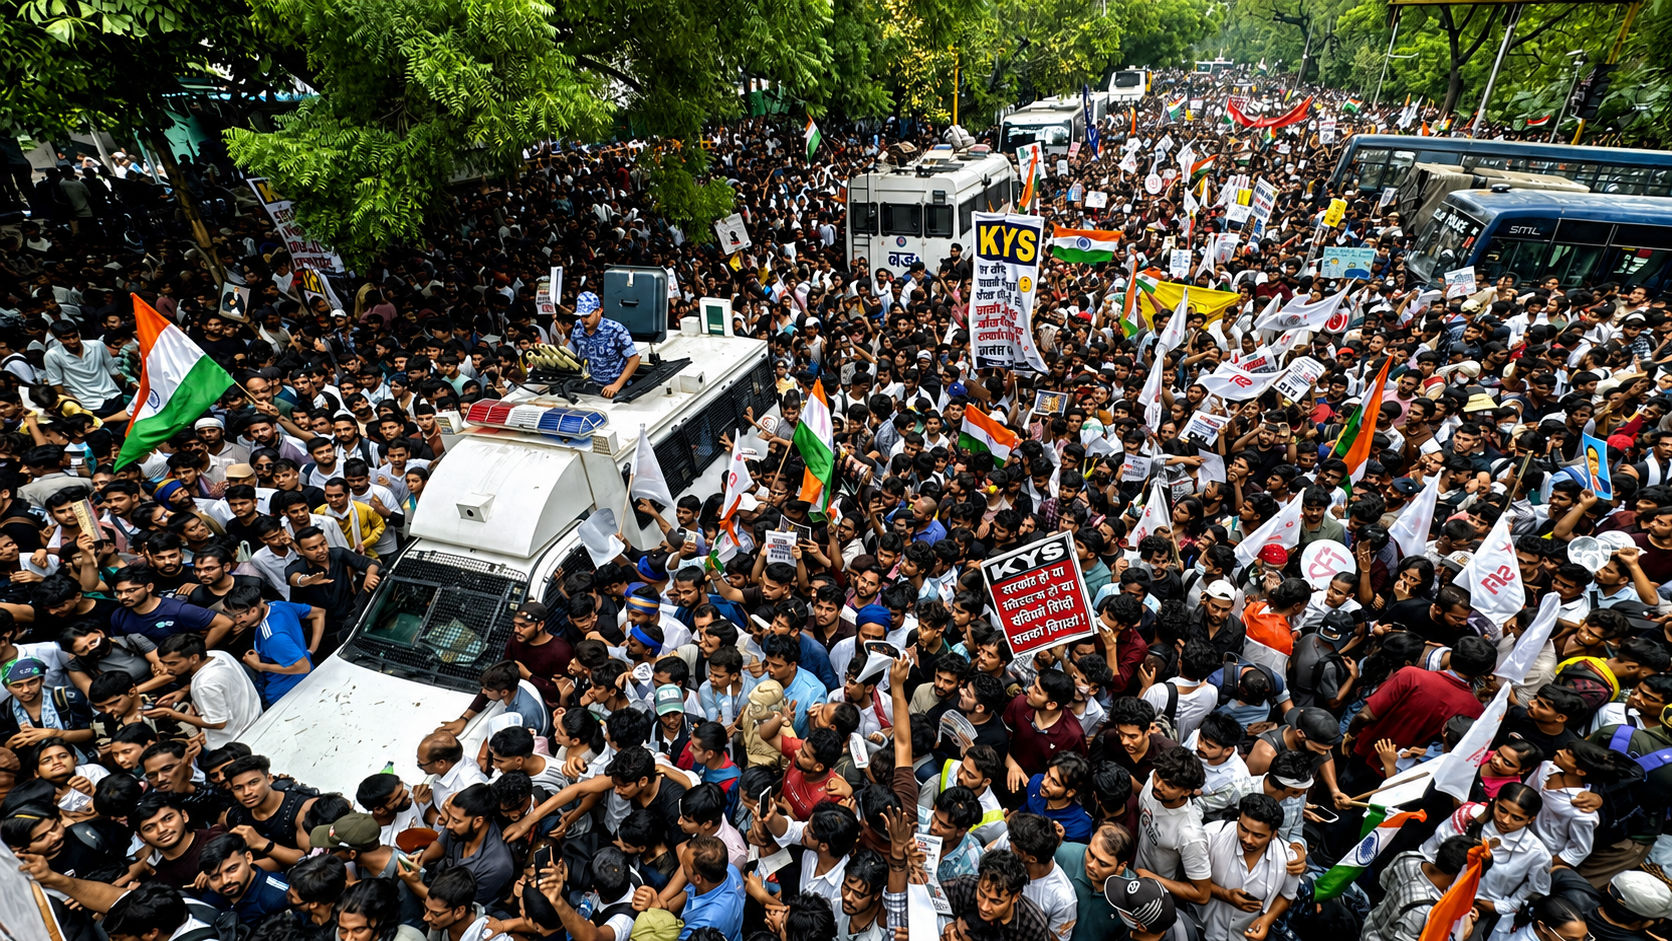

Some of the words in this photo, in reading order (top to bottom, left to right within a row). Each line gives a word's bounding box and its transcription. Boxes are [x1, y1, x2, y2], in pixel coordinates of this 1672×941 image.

[979, 225, 1037, 262] KYS
[1508, 225, 1541, 236] SML
[990, 541, 1065, 581] KYS
